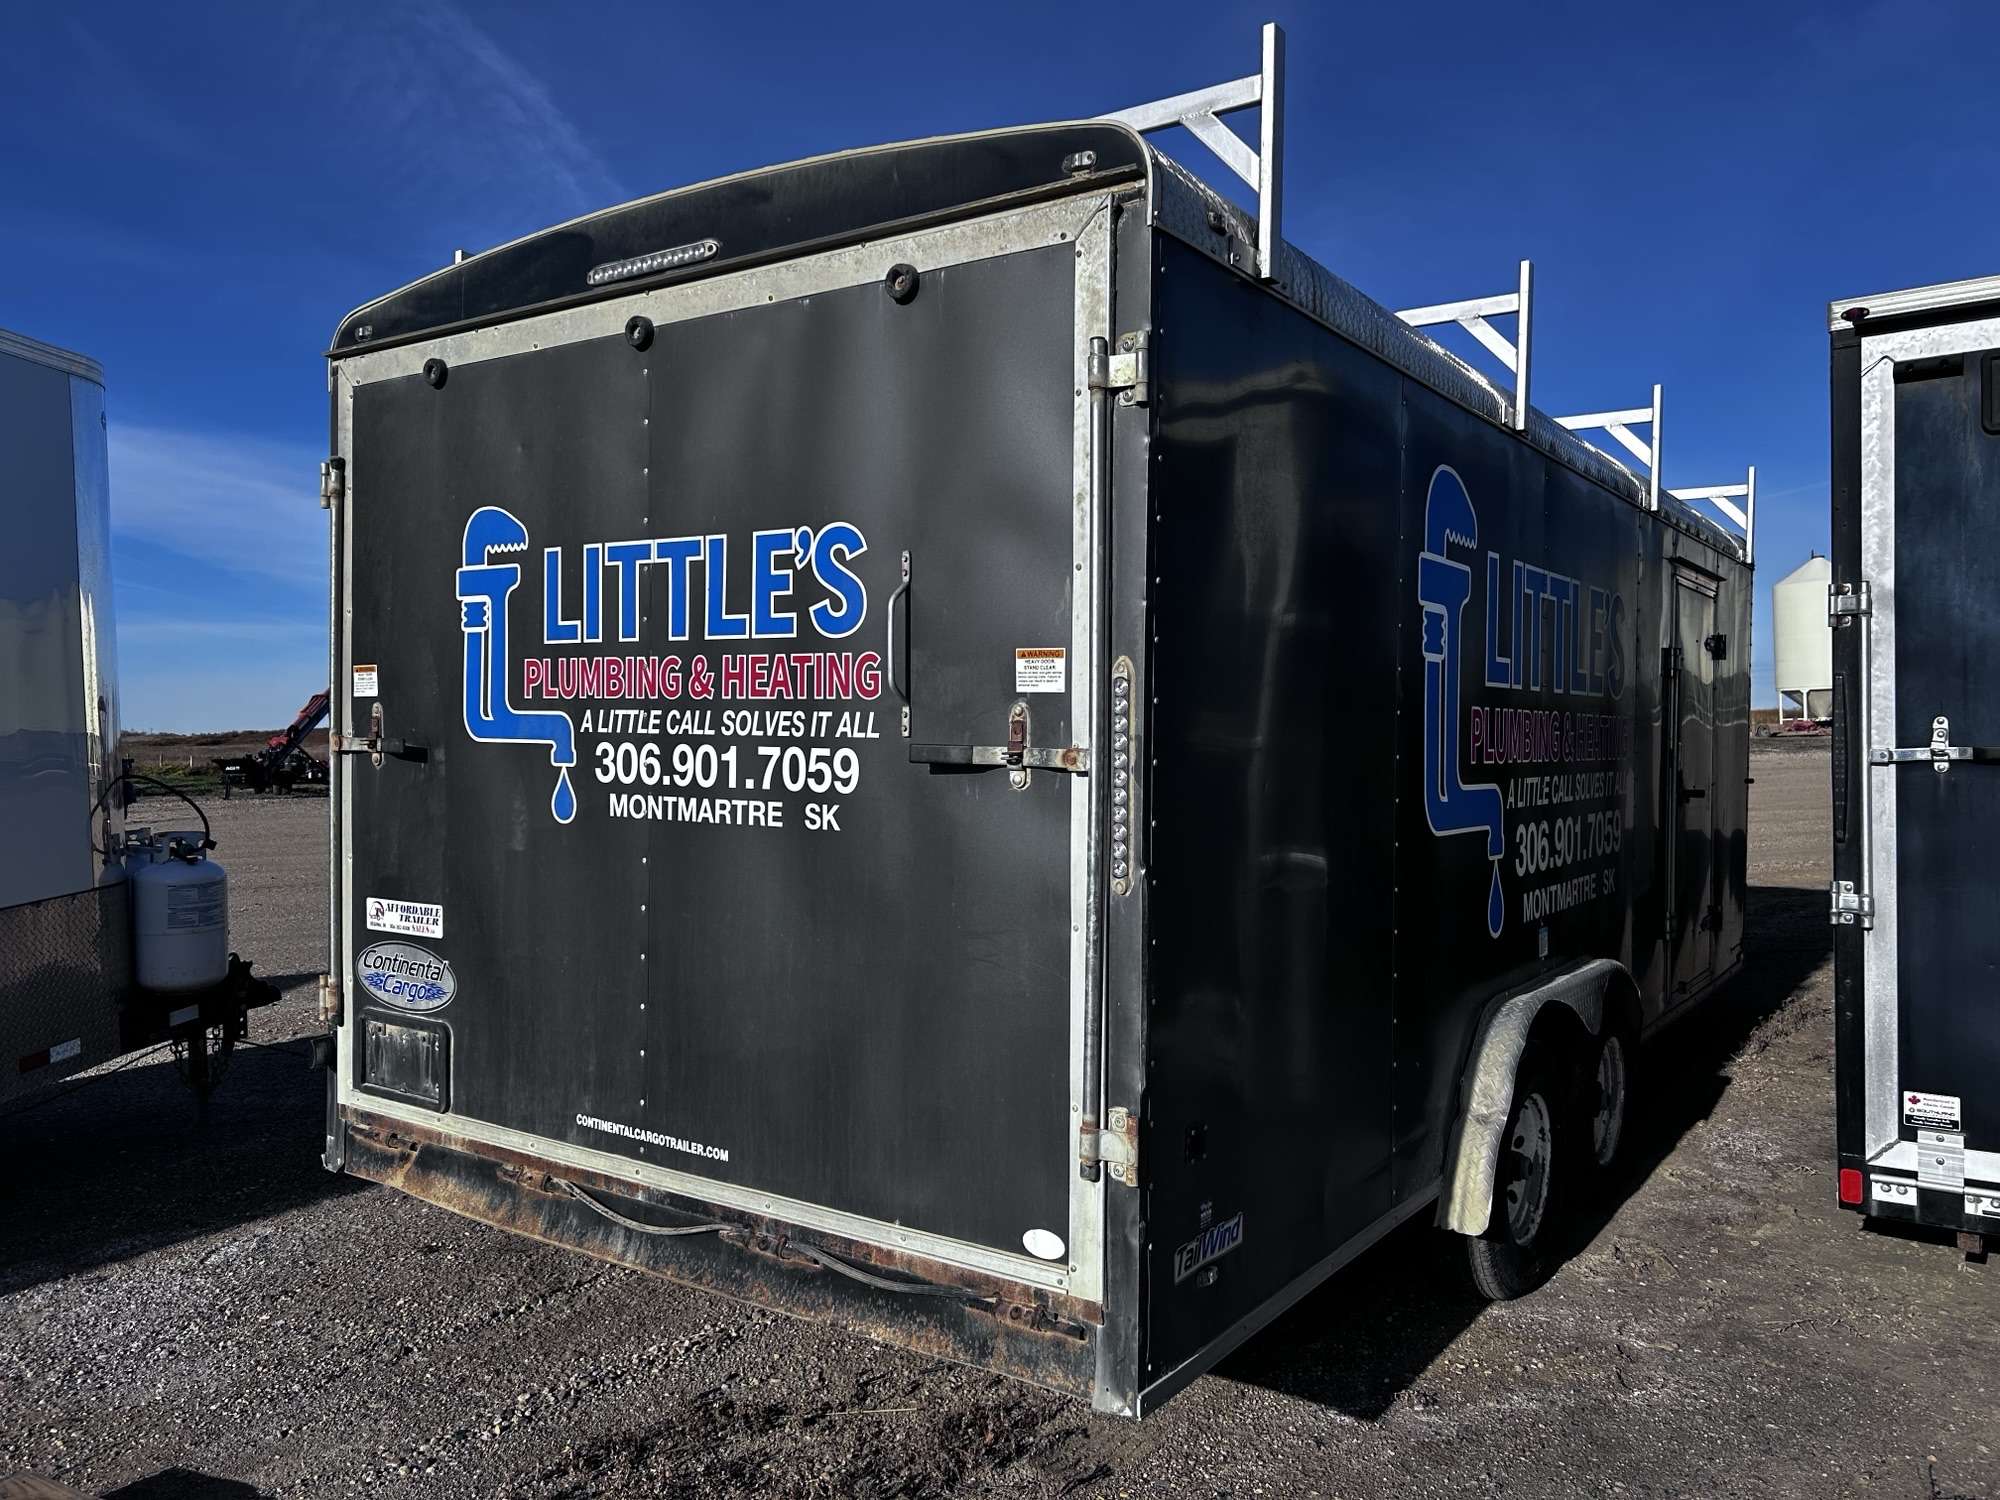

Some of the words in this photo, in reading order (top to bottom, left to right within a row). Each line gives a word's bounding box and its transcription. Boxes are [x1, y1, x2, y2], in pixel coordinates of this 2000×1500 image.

[544, 522, 867, 644] LITTLE'S
[1485, 550, 1625, 700] LITTLE'S
[524, 656, 681, 699] PLUMBING
[688, 655, 714, 699] &
[722, 651, 882, 700] HEATING
[581, 709, 593, 733] A
[597, 709, 662, 734] LITTLE
[666, 709, 715, 736] CALL
[721, 710, 805, 738] SOLVES
[810, 710, 831, 738] IT
[835, 710, 881, 739] ALL
[1470, 706, 1561, 764] PLUMBING
[1562, 711, 1575, 762] &
[594, 742, 860, 794] 306.901.7059
[1506, 778, 1515, 808] A
[1517, 776, 1550, 808] LITTLE
[1552, 774, 1573, 804] CALL
[1575, 771, 1604, 800] SOLVES
[1605, 771, 1614, 797] IT
[609, 793, 783, 828] MONTMARTRE
[804, 804, 841, 831] SK
[1515, 809, 1621, 877] 306.901.7059
[385, 903, 441, 918] AFFORDABLE
[399, 914, 439, 926] TRAILER
[1523, 873, 1597, 924] MONTMARTRE
[1602, 868, 1616, 895] SK
[363, 949, 447, 981] Continental
[382, 974, 427, 1003] Cargo
[576, 1113, 729, 1162] CONTINENTALCARGOTRAILER.COM
